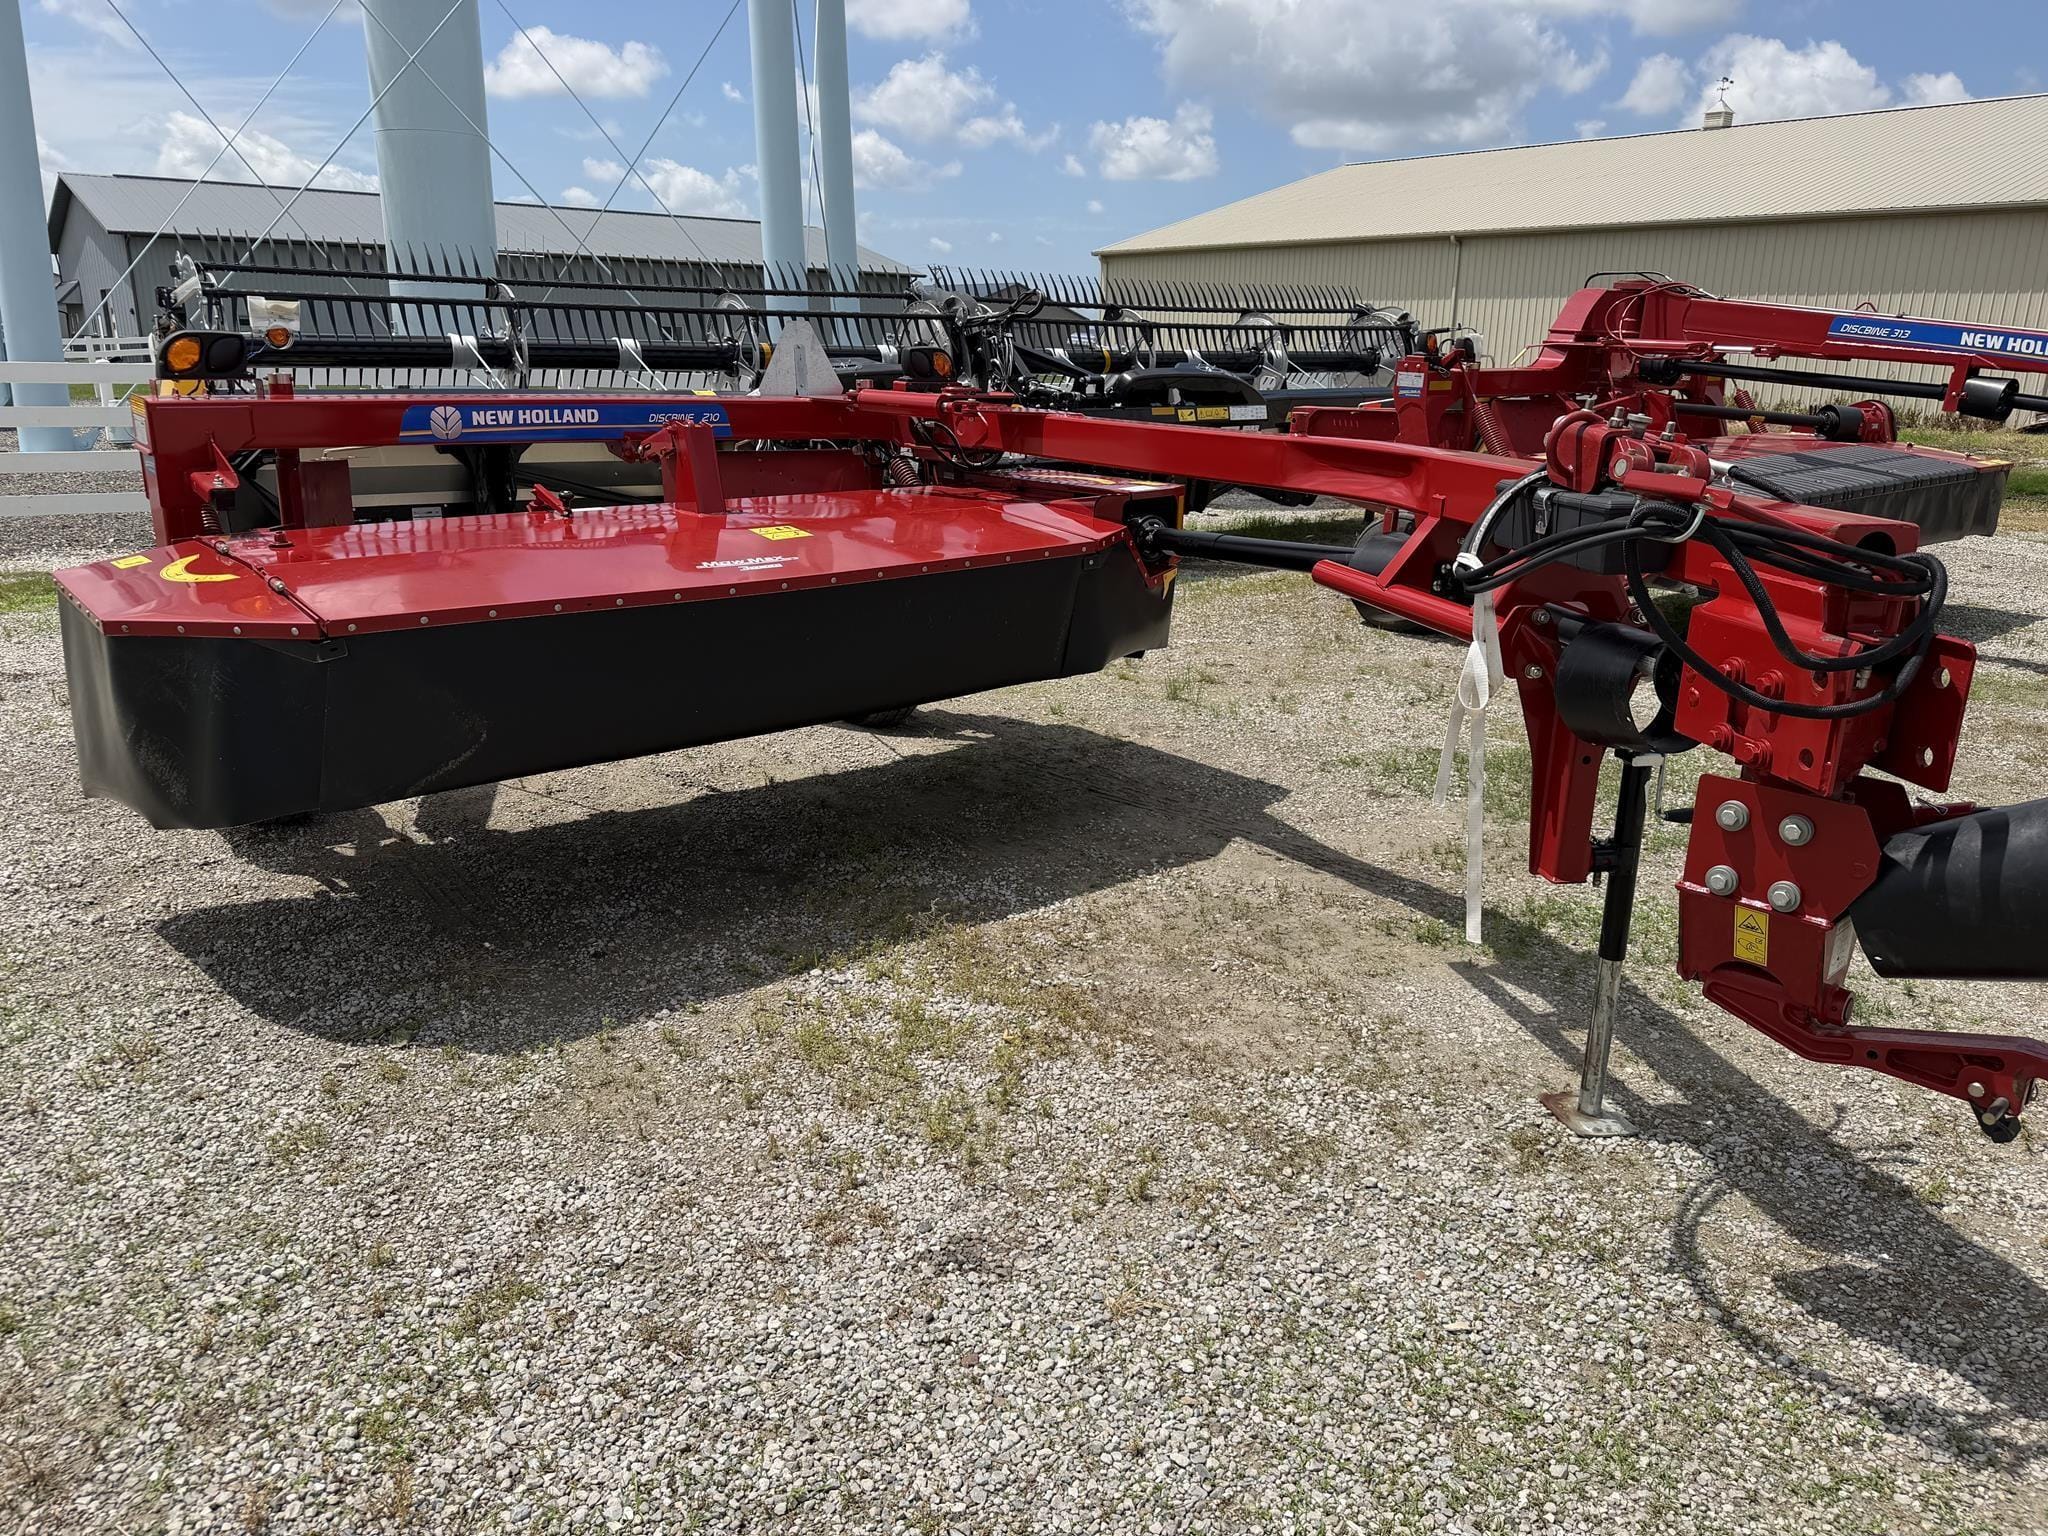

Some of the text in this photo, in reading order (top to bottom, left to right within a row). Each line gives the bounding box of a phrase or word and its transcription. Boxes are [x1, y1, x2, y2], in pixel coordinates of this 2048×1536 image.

[1840, 323, 1911, 339] DISCBINE 313
[1960, 331, 2004, 350] NEW
[472, 409, 599, 426] NEW HOLLAND
[702, 413, 720, 422] 210
